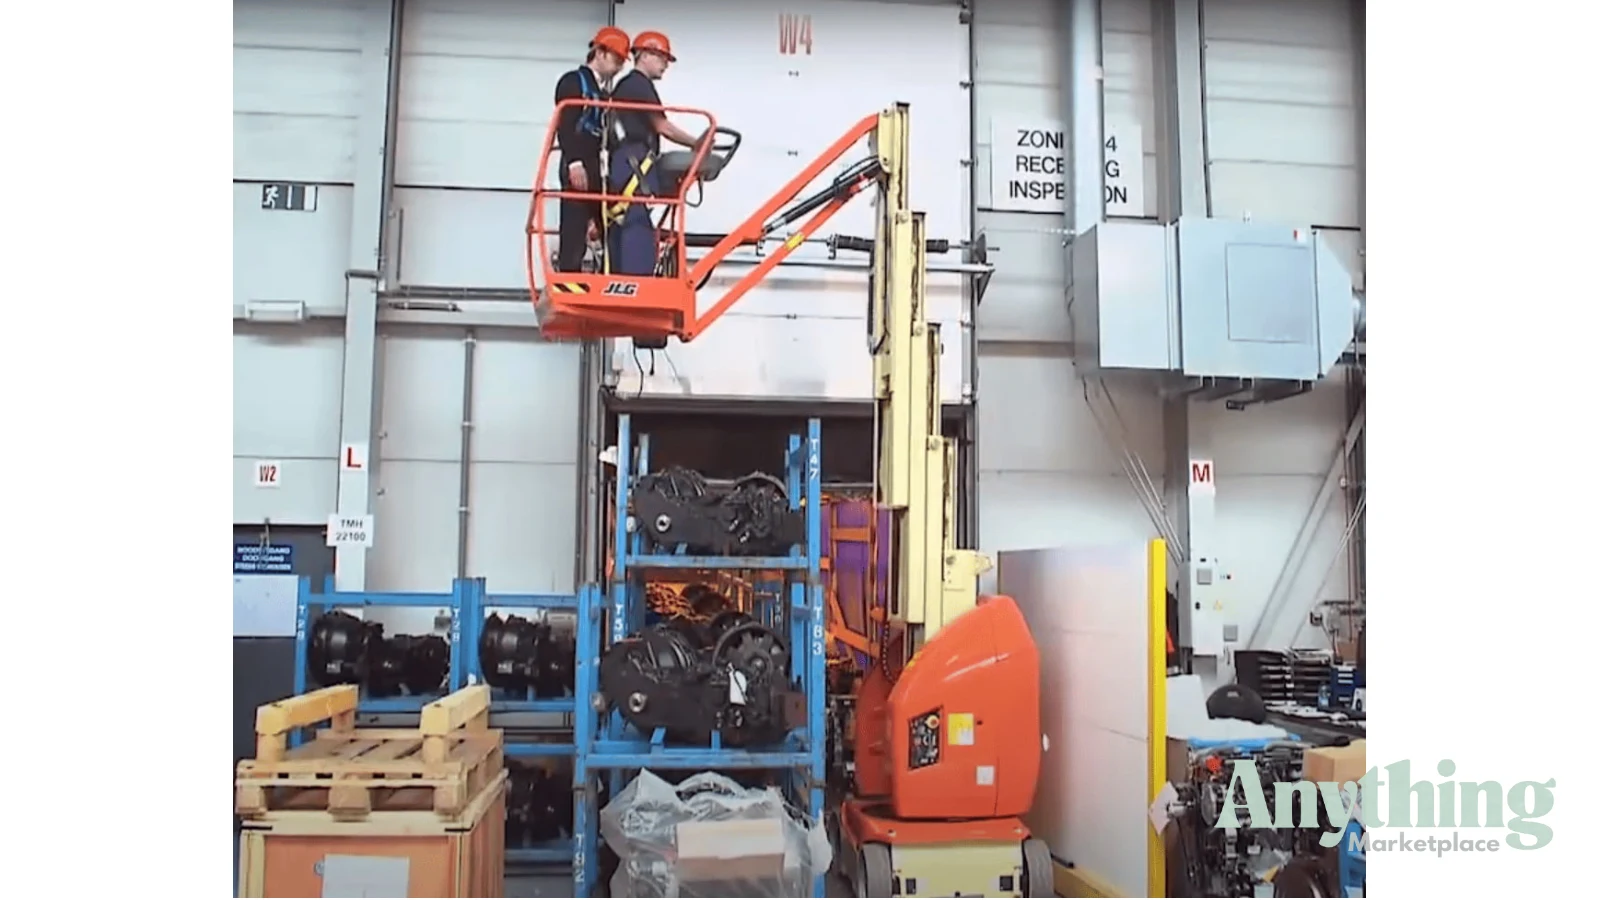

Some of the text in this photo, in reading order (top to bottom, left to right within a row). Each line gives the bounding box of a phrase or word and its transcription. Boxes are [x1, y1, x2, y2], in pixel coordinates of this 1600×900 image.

[778, 13, 812, 55] W4
[1016, 155, 1120, 179] RECEG
[1009, 180, 1128, 204] INSPEON
[602, 282, 638, 297] JLG
[346, 446, 362, 469] L
[809, 438, 818, 480] T47
[259, 464, 276, 483] W2
[1192, 463, 1210, 483] M
[340, 518, 363, 529] TMH
[335, 532, 366, 542] 22100
